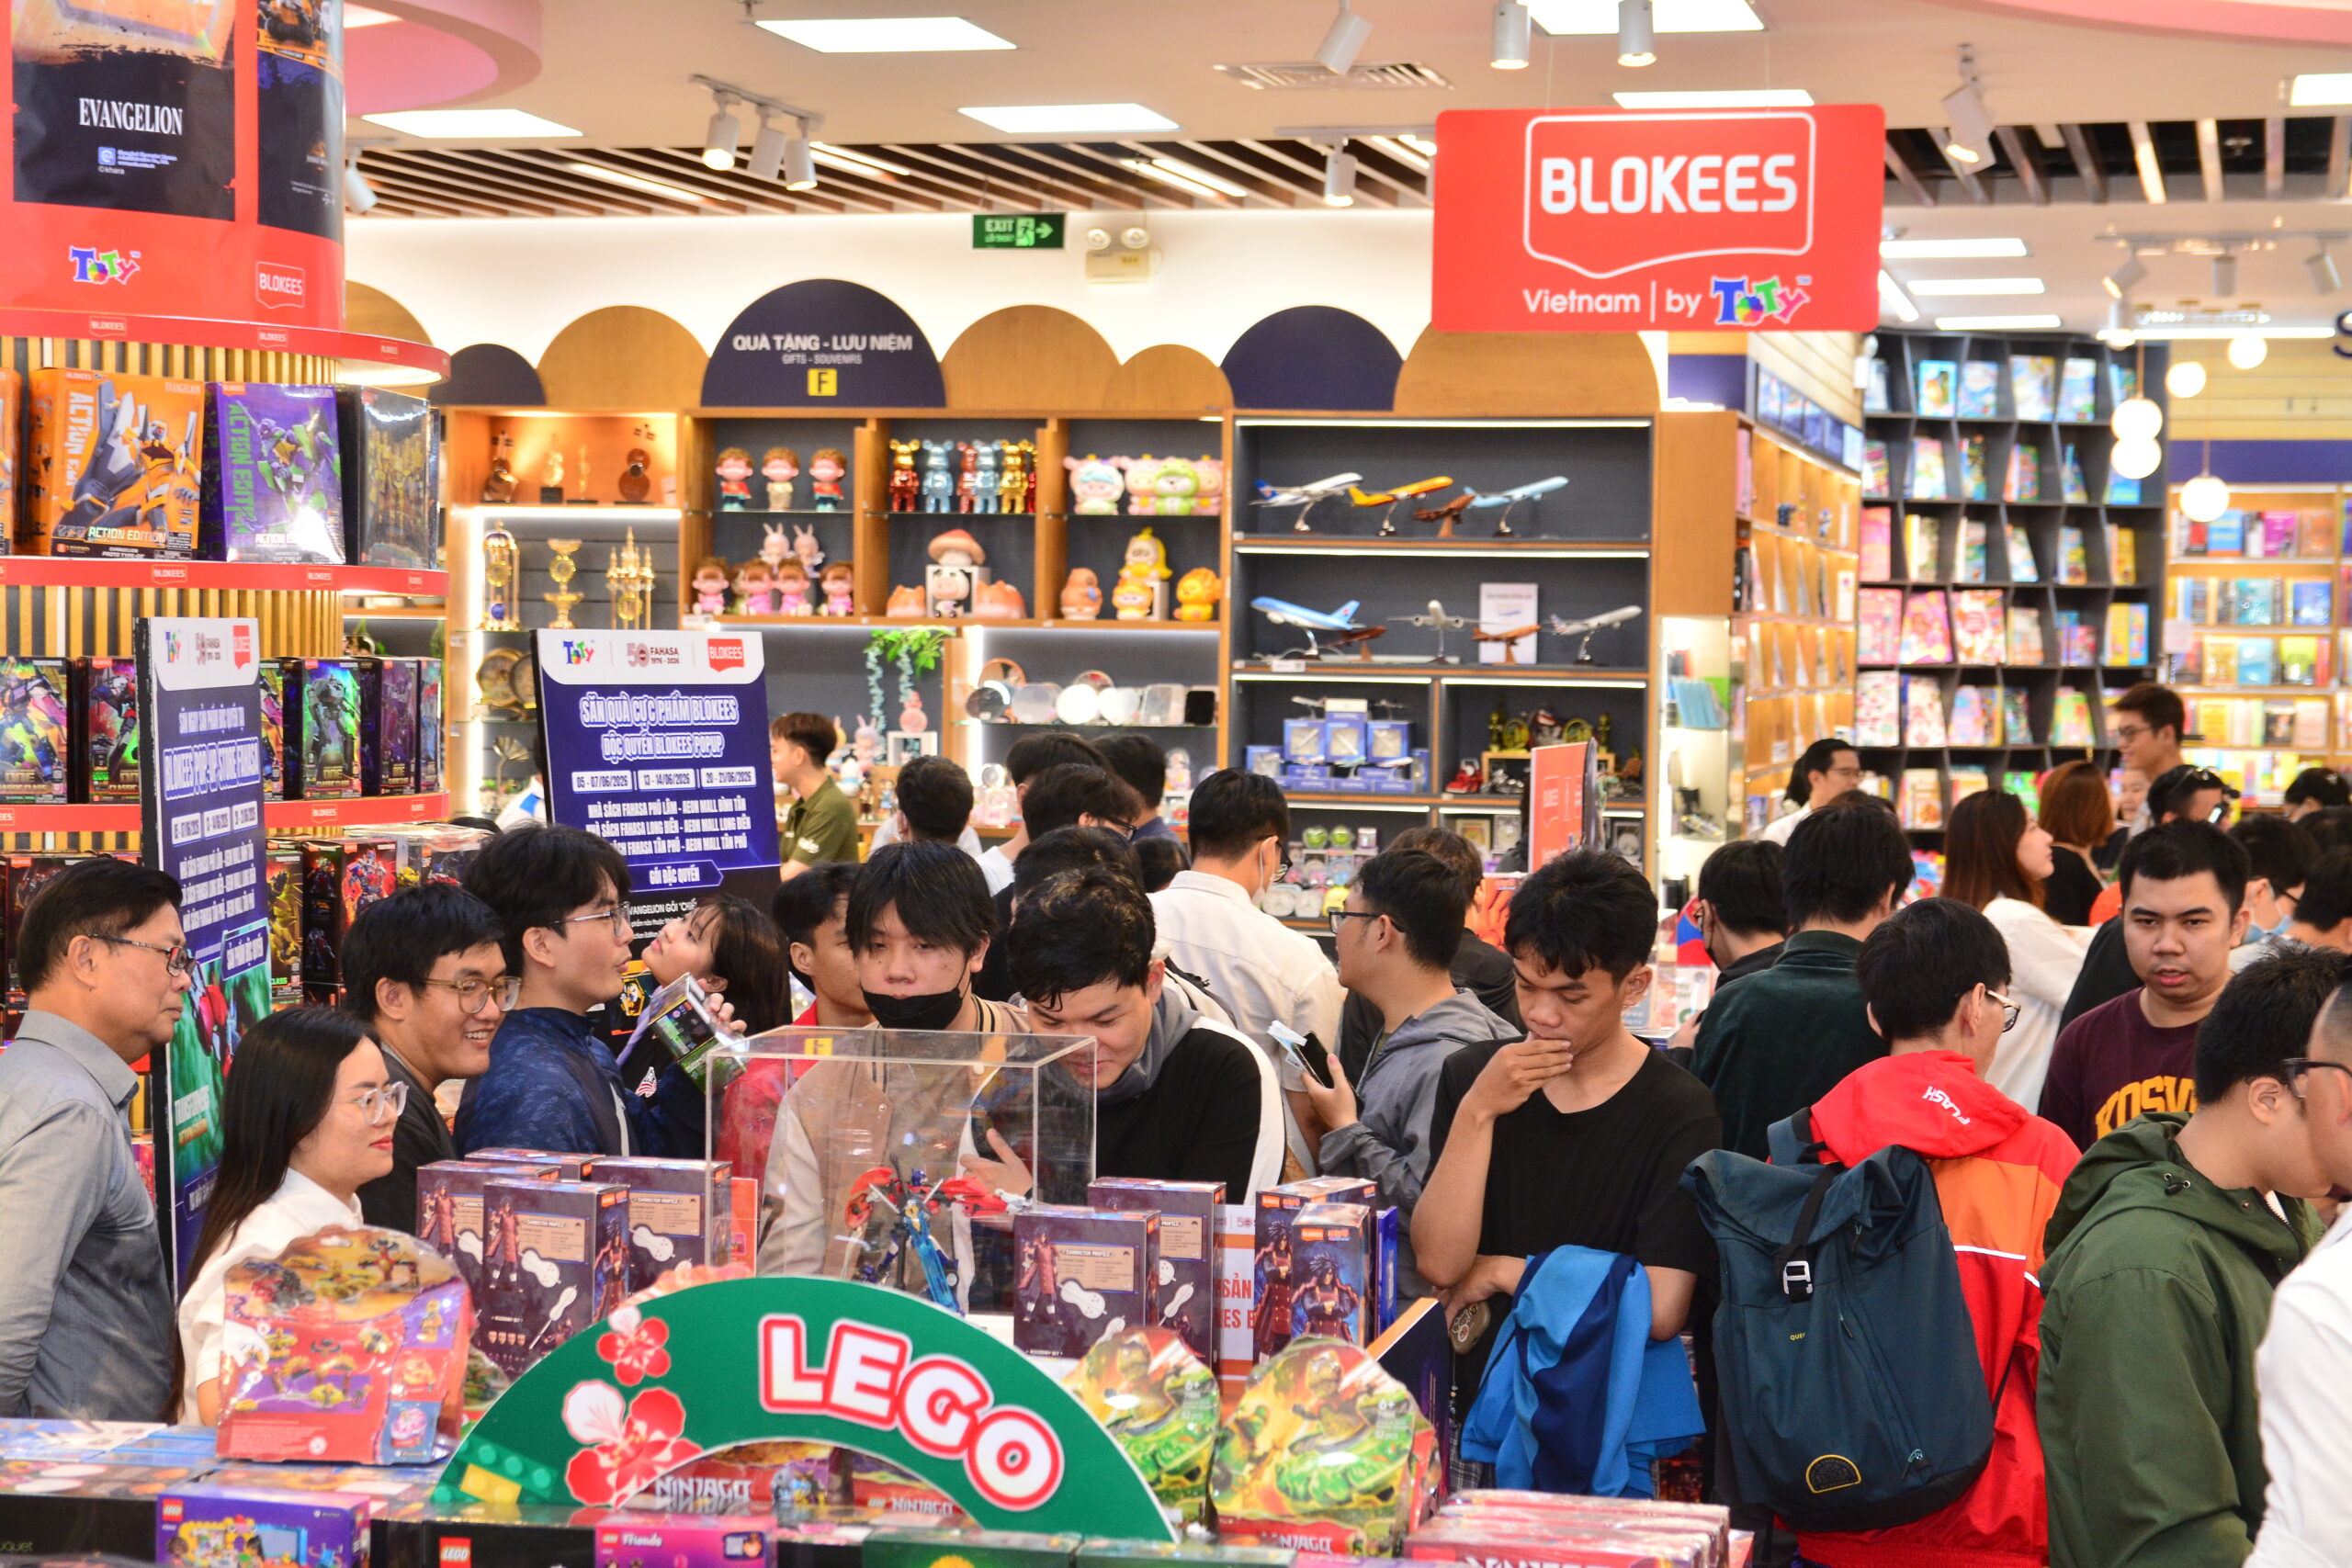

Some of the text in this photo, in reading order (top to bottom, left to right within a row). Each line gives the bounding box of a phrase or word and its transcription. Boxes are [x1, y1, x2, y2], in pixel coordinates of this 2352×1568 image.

[79, 97, 183, 136] EVANGELION
[1541, 154, 1798, 214] BLOKEES
[985, 218, 1014, 232] EXIT
[259, 272, 303, 296] BLOKEES
[1522, 288, 1641, 314] Vietnam
[1666, 288, 1702, 318] by
[91, 321, 125, 332] BLOKEES
[258, 332, 287, 343] BLOKEES
[732, 333, 771, 352] QUÀ
[781, 354, 808, 365] GIFTS
[817, 371, 829, 393] F
[227, 403, 254, 466] ACTION
[87, 525, 126, 540] ACTION
[153, 567, 186, 580] BLOKEES
[650, 647, 679, 656] FAHASA
[708, 646, 743, 660] BLOKEES
[581, 692, 606, 725] SĂN
[691, 695, 739, 724] BLOKEES
[654, 733, 693, 758] BLOKEES
[694, 732, 724, 757] POPUP
[312, 807, 337, 817] BLOKEES
[628, 903, 665, 916] VANGELION
[1922, 1086, 1971, 1125] FLASH
[759, 1314, 1064, 1513] LEGO
[655, 1475, 752, 1503] NINJAGO
[164, 1506, 182, 1517] LEGO
[891, 1496, 954, 1515] NINJAGO
[622, 1532, 662, 1548] Friends
[441, 1548, 470, 1562] LEGO
